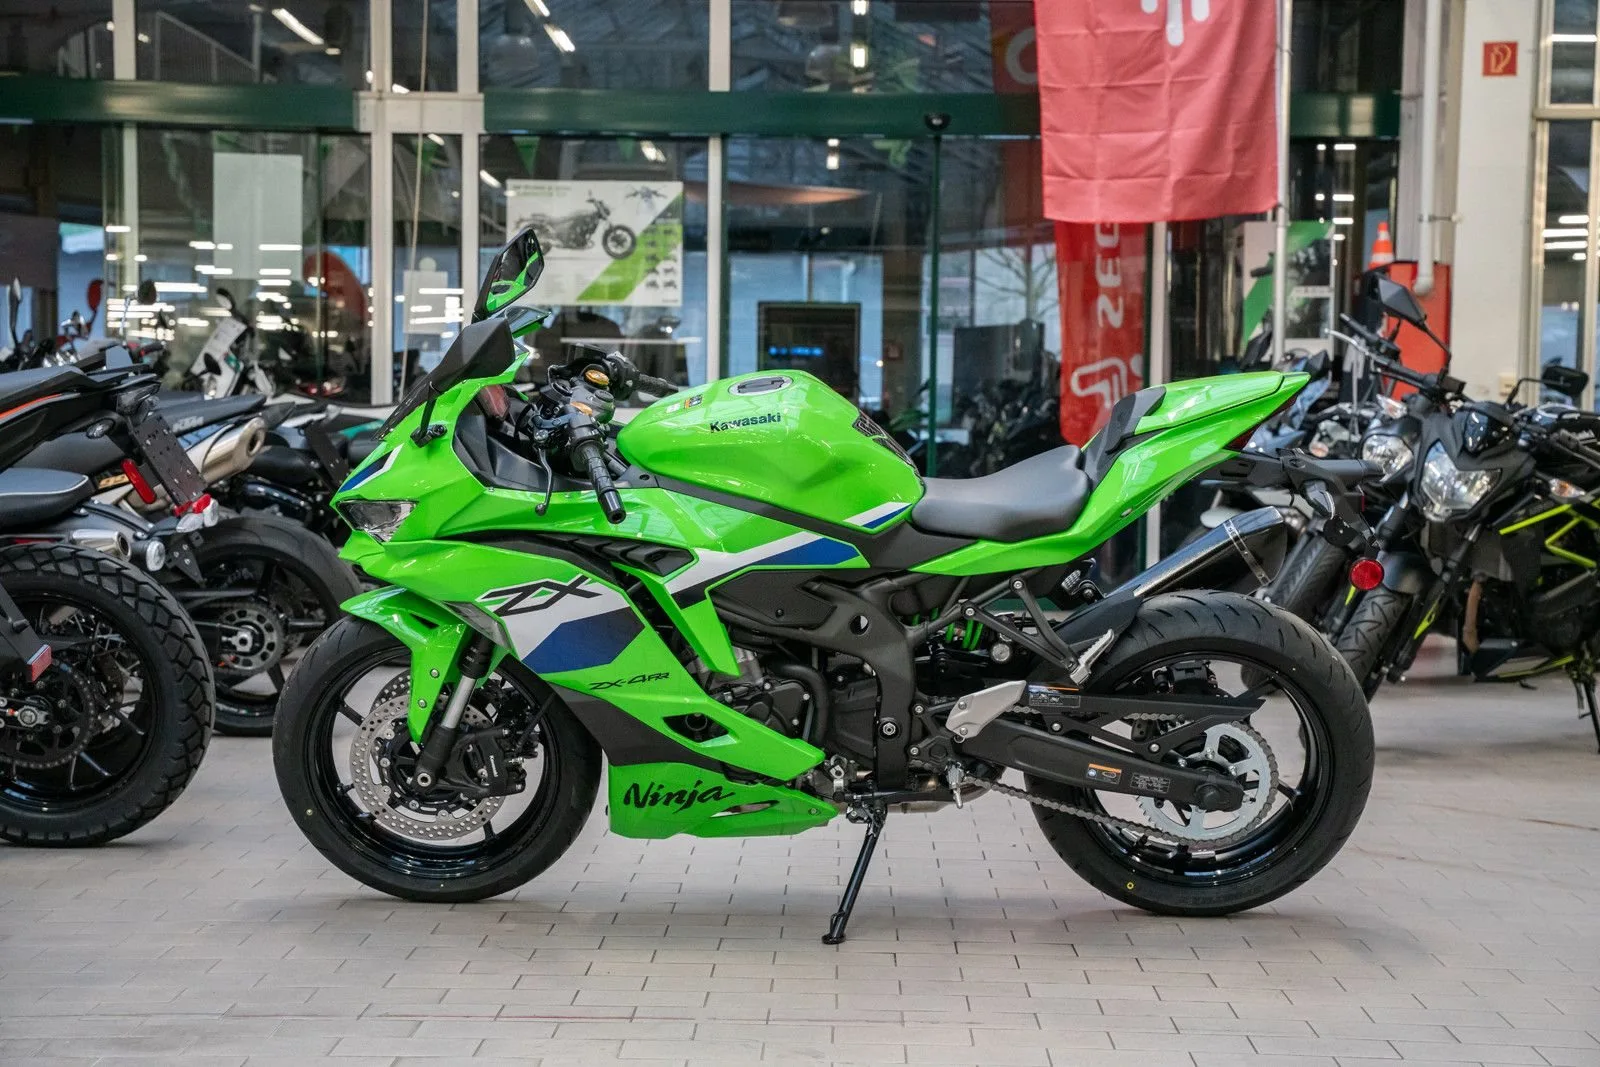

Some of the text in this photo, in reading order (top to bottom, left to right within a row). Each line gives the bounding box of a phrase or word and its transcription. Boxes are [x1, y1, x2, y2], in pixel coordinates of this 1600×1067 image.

[710, 412, 781, 433] Kawasaki
[481, 574, 603, 617] ZX
[623, 780, 736, 814] Ninja
